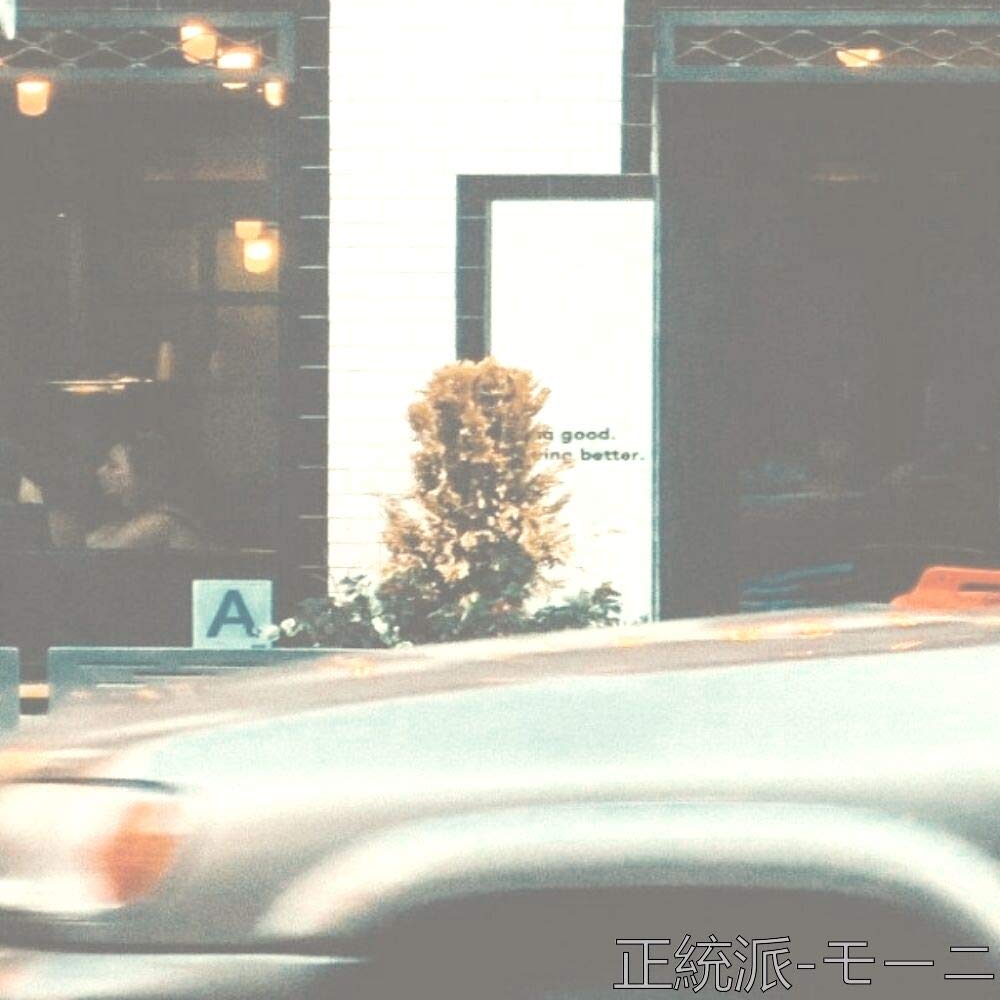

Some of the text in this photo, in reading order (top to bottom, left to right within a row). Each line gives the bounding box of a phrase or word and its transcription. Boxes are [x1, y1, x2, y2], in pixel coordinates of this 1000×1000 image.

[561, 427, 616, 444] good.
[580, 447, 646, 462] better.
[206, 589, 260, 639] A
